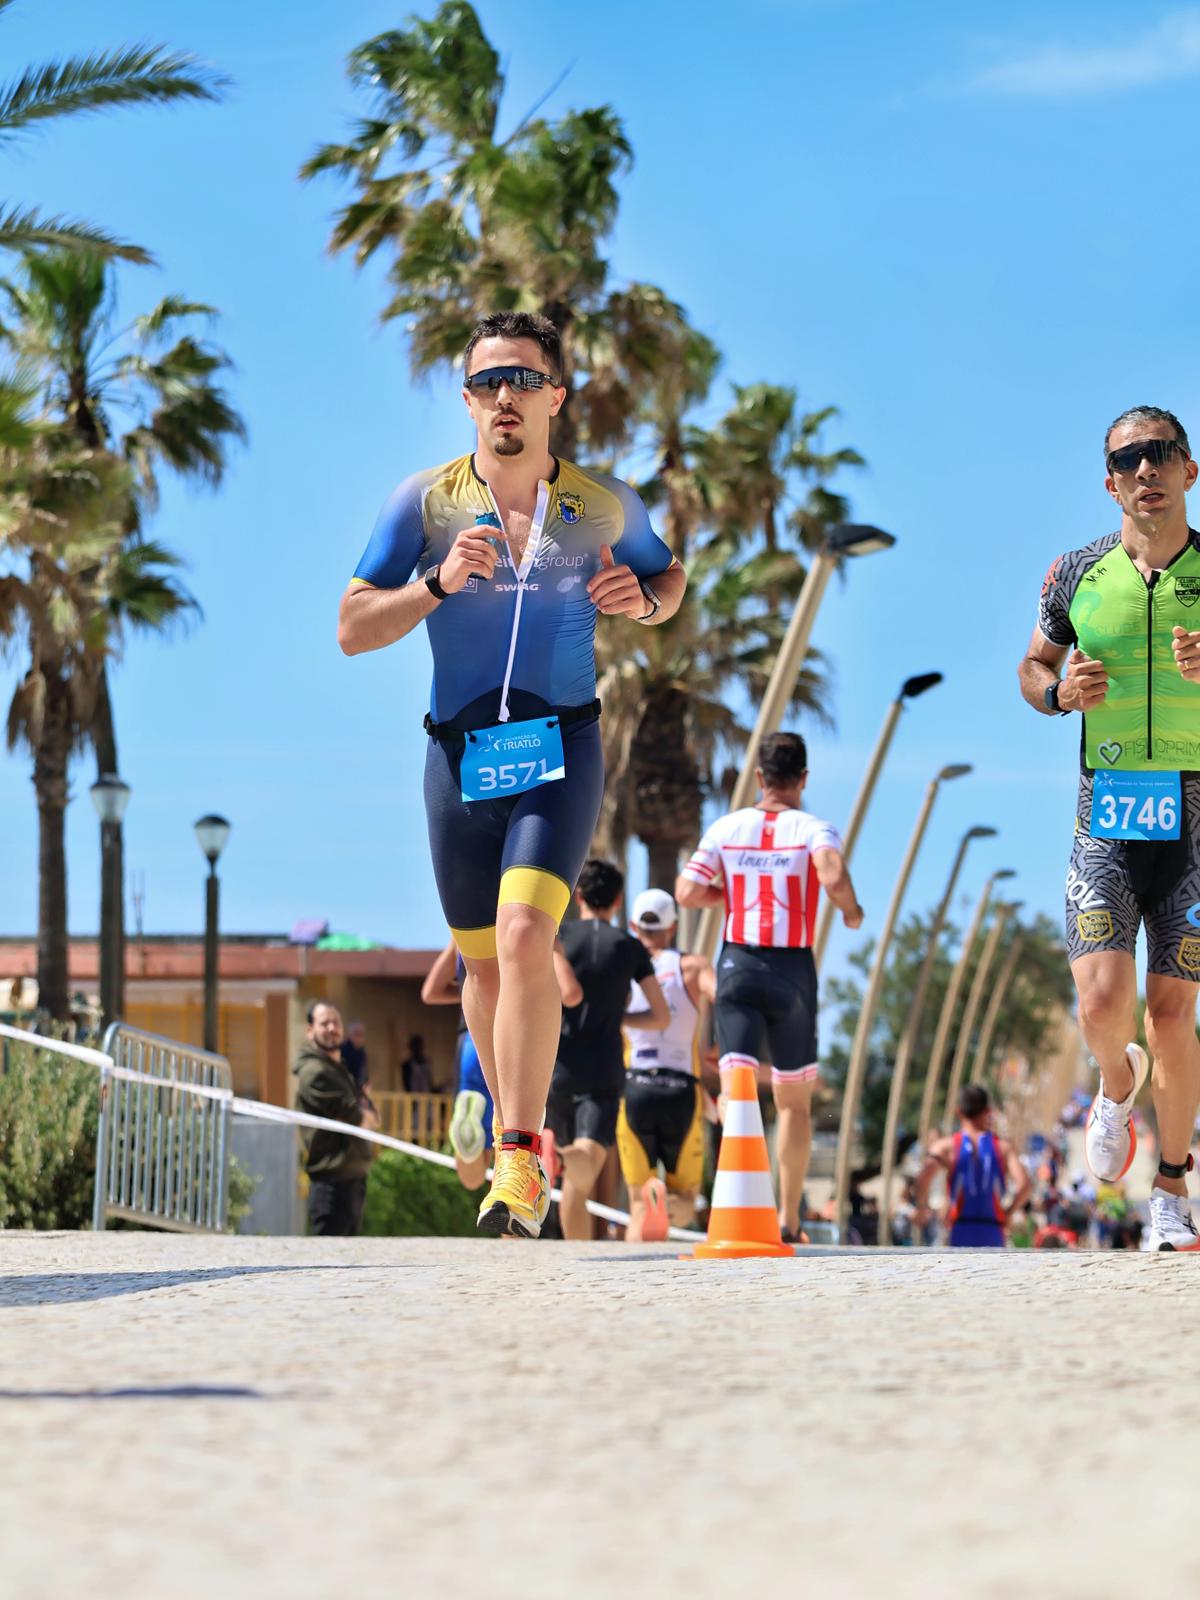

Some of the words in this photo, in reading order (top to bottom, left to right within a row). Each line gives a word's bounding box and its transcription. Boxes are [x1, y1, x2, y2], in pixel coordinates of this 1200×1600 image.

[503, 738, 542, 751] TRIATLO
[477, 757, 548, 791] 3571
[1098, 794, 1177, 831] 3746
